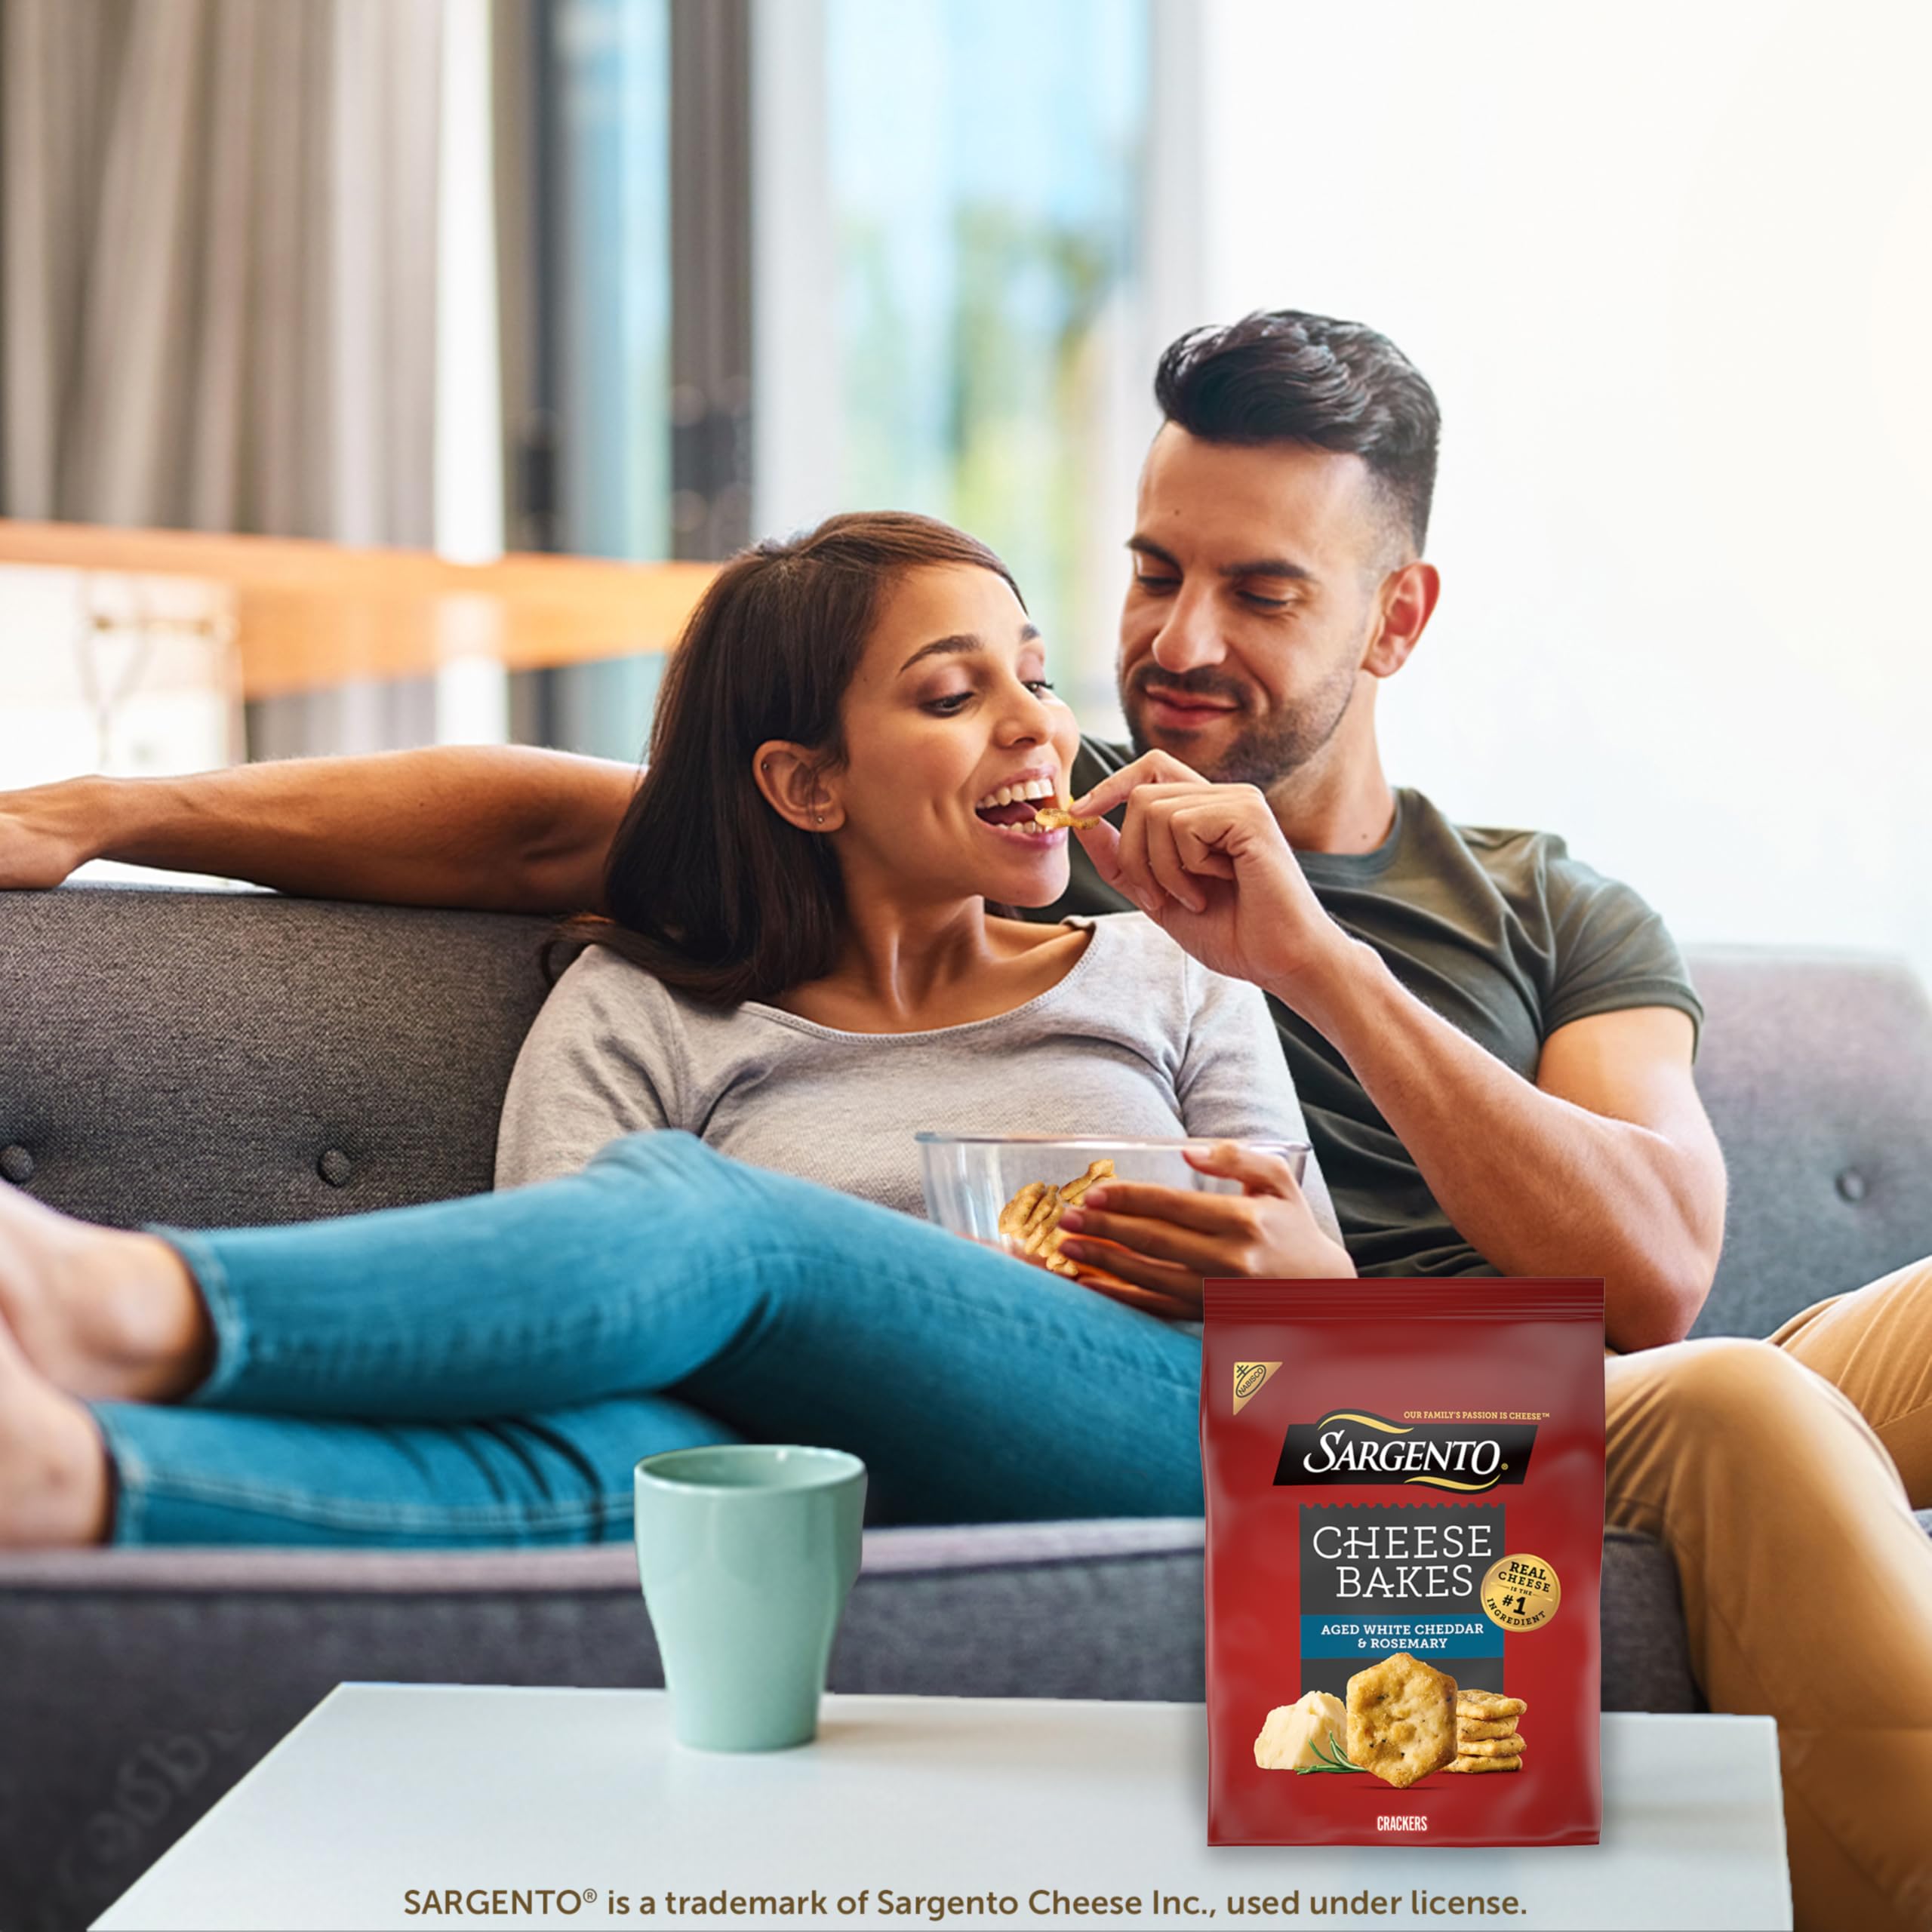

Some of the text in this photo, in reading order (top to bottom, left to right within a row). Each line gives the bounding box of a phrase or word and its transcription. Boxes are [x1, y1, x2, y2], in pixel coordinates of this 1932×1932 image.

[1238, 1367, 1264, 1395] NABISCO
[1403, 1411, 1423, 1420] OUR
[1423, 1411, 1461, 1420] FAMILY'S
[1462, 1411, 1498, 1420] PASSION
[1500, 1411, 1508, 1420] IS
[1312, 1525, 1491, 1559] CHEESE
[1509, 1561, 1546, 1580] REAL
[1336, 1564, 1473, 1598] BAKES
[1498, 1571, 1551, 1592] CHEESE
[1519, 1588, 1533, 1596] THE
[1487, 1598, 1546, 1626] INGREDIENT
[1502, 1595, 1526, 1615] #1
[1321, 1623, 1484, 1635] AGED WHITE CHEDDAR
[1358, 1638, 1447, 1649] & ROSEMARY
[1377, 1816, 1428, 1832] CRACKERS
